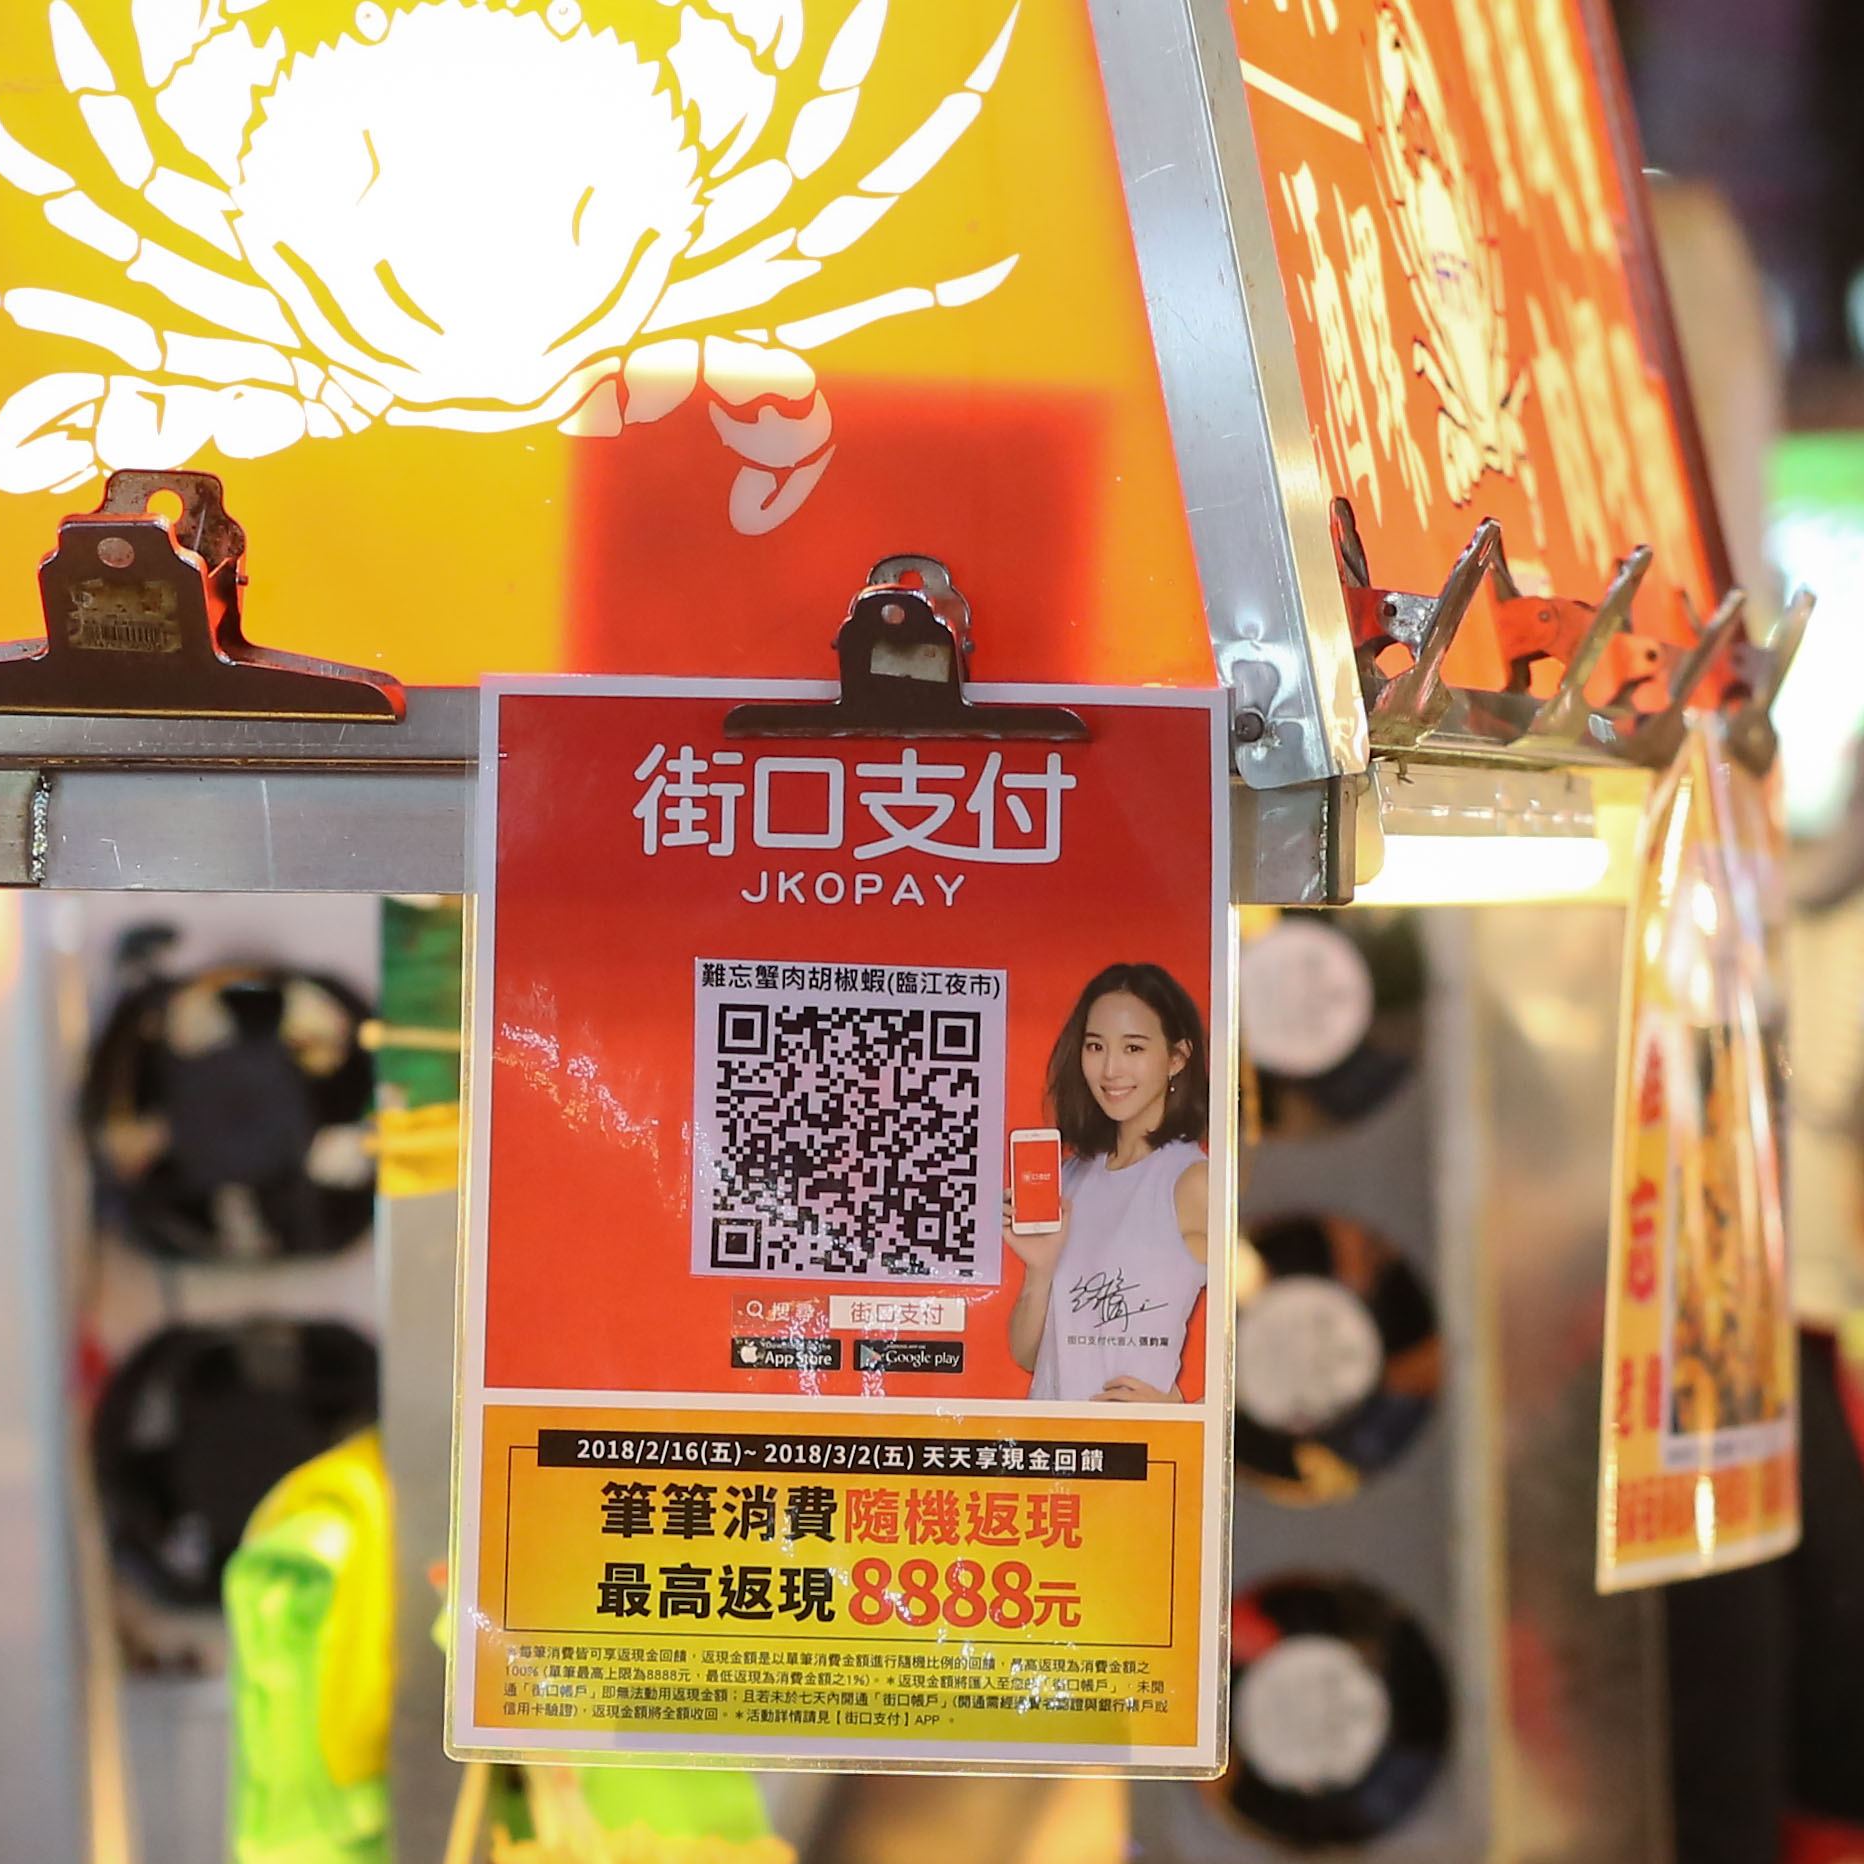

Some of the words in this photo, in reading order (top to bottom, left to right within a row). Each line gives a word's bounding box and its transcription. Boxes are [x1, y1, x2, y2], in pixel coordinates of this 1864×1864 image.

[631, 742, 1077, 864] 街口支付
[740, 870, 967, 907] JKOPAY
[701, 962, 1002, 1000] 難忘蟹肉胡椒蝦(臨江夜市)
[850, 1302, 945, 1326] 街口支付
[764, 1351, 794, 1368] App
[795, 1351, 833, 1367] Store
[885, 1350, 931, 1368] Google
[934, 1352, 960, 1367] play
[763, 1442, 915, 1470] 2018/3/2(五)
[922, 1445, 1105, 1473] 天天享現金回饋
[600, 1481, 1084, 1550] 筆筆消費隨機返現
